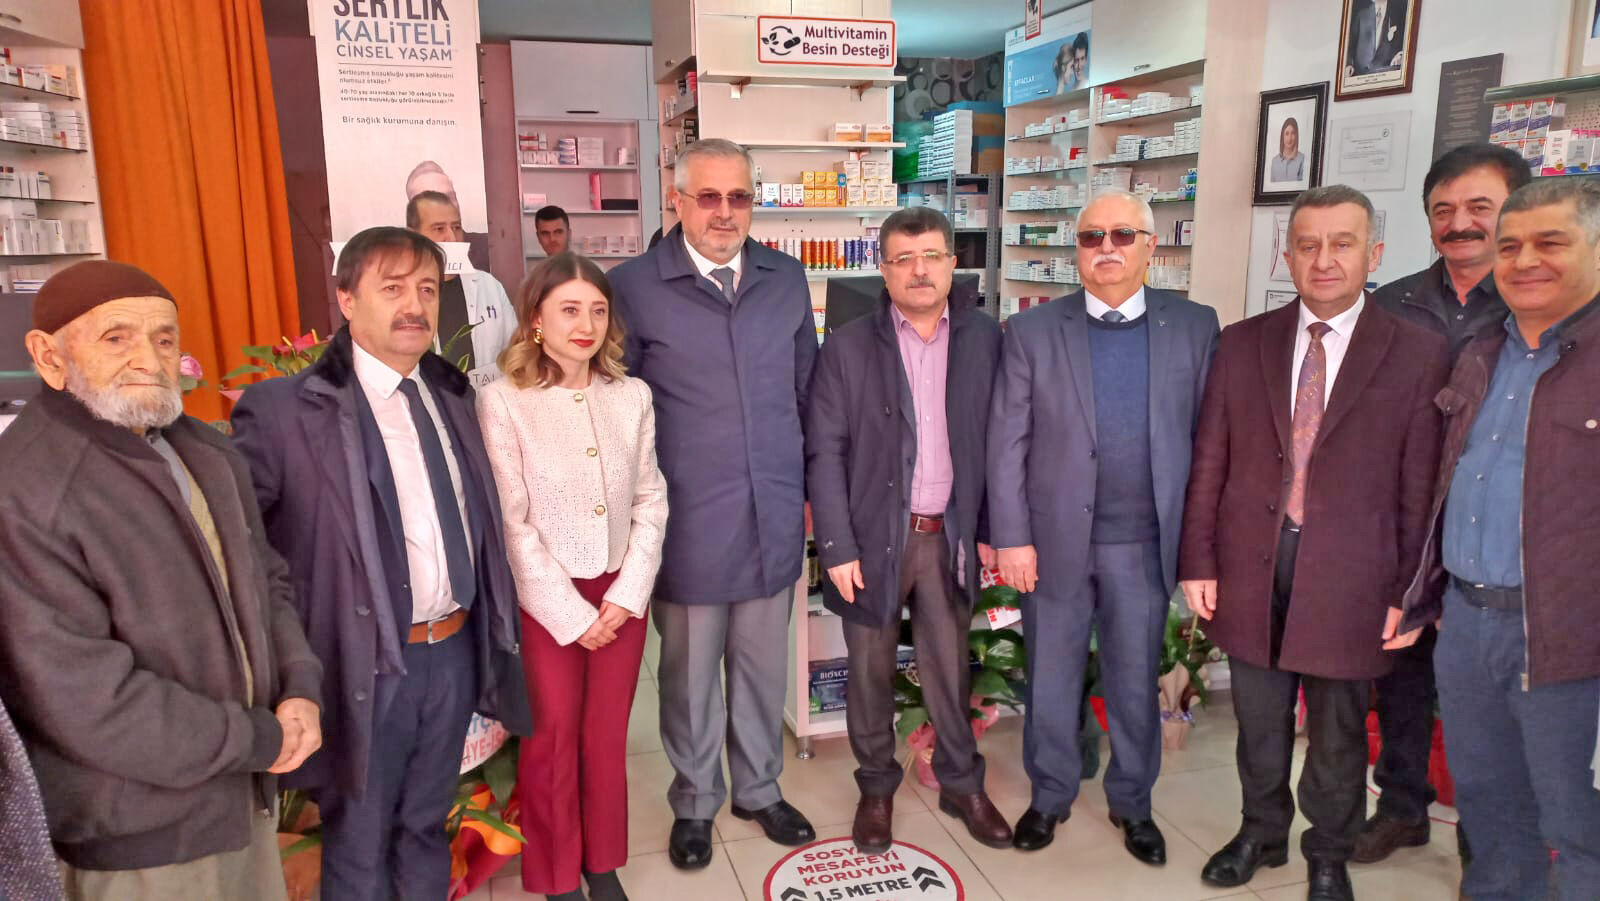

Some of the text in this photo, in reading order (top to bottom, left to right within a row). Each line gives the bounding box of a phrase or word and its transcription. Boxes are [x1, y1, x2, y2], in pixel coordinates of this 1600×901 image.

[804, 25, 888, 41] Multivitamin
[337, 43, 453, 62] CİNSEL YAŞAM
[802, 43, 890, 60] Besin Desteği
[342, 115, 354, 123] Bir
[356, 116, 381, 125] sağlık
[383, 117, 424, 125] kurumuna
[797, 850, 900, 875] MESAFEYİ
[803, 847, 862, 862] SOSY
[803, 863, 907, 886] KORUYUN
[814, 877, 912, 901] 1,5 METRE
